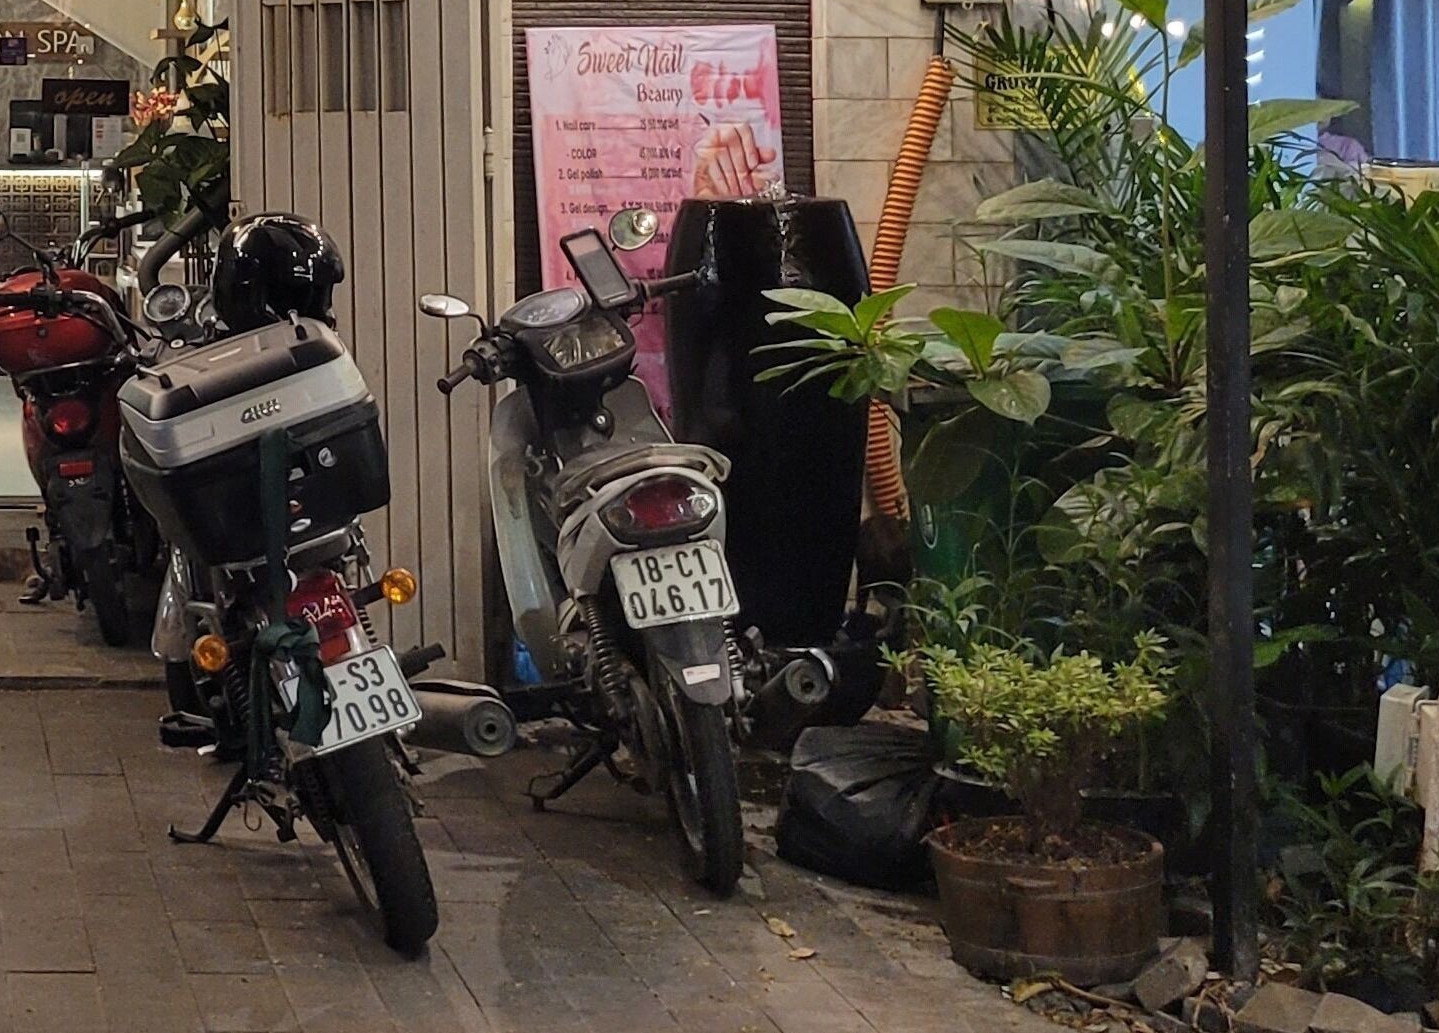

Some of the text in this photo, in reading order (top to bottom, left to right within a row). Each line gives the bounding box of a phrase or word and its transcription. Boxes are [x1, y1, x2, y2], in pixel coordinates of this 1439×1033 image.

[37, 29, 81, 54] SPA
[576, 41, 686, 78] Sweet Nail
[630, 547, 708, 587] 18-C1
